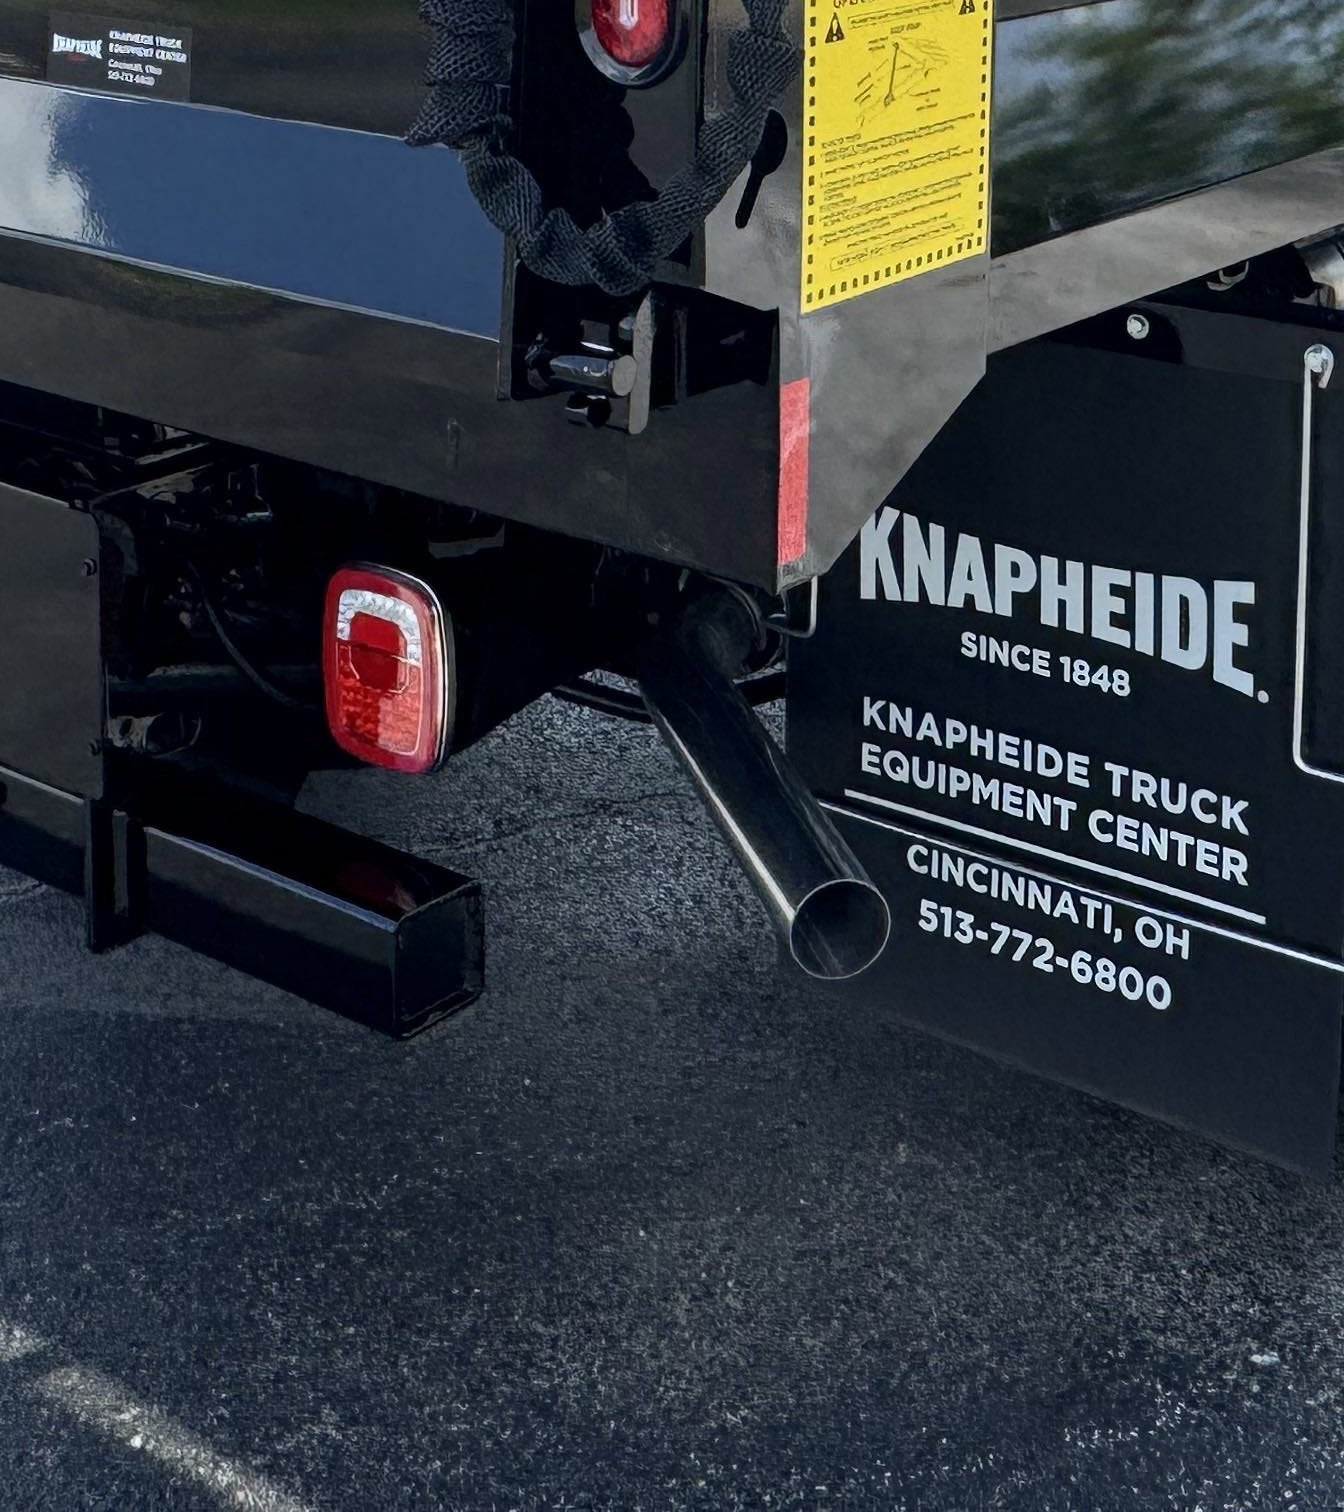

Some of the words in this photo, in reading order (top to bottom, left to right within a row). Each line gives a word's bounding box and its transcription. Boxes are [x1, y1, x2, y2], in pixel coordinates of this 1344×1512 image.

[960, 631, 1051, 678] SINCE
[1059, 655, 1131, 697] 1848
[861, 742, 1078, 832] EQUIPMENT
[1088, 809, 1249, 886] CENTER
[862, 696, 1090, 789] KNAPHEIDE
[1104, 761, 1249, 836] TRUCK
[906, 844, 1123, 944] CINCINNATI,
[1134, 915, 1190, 960] OH
[918, 898, 1172, 1010] 513-772-6800
